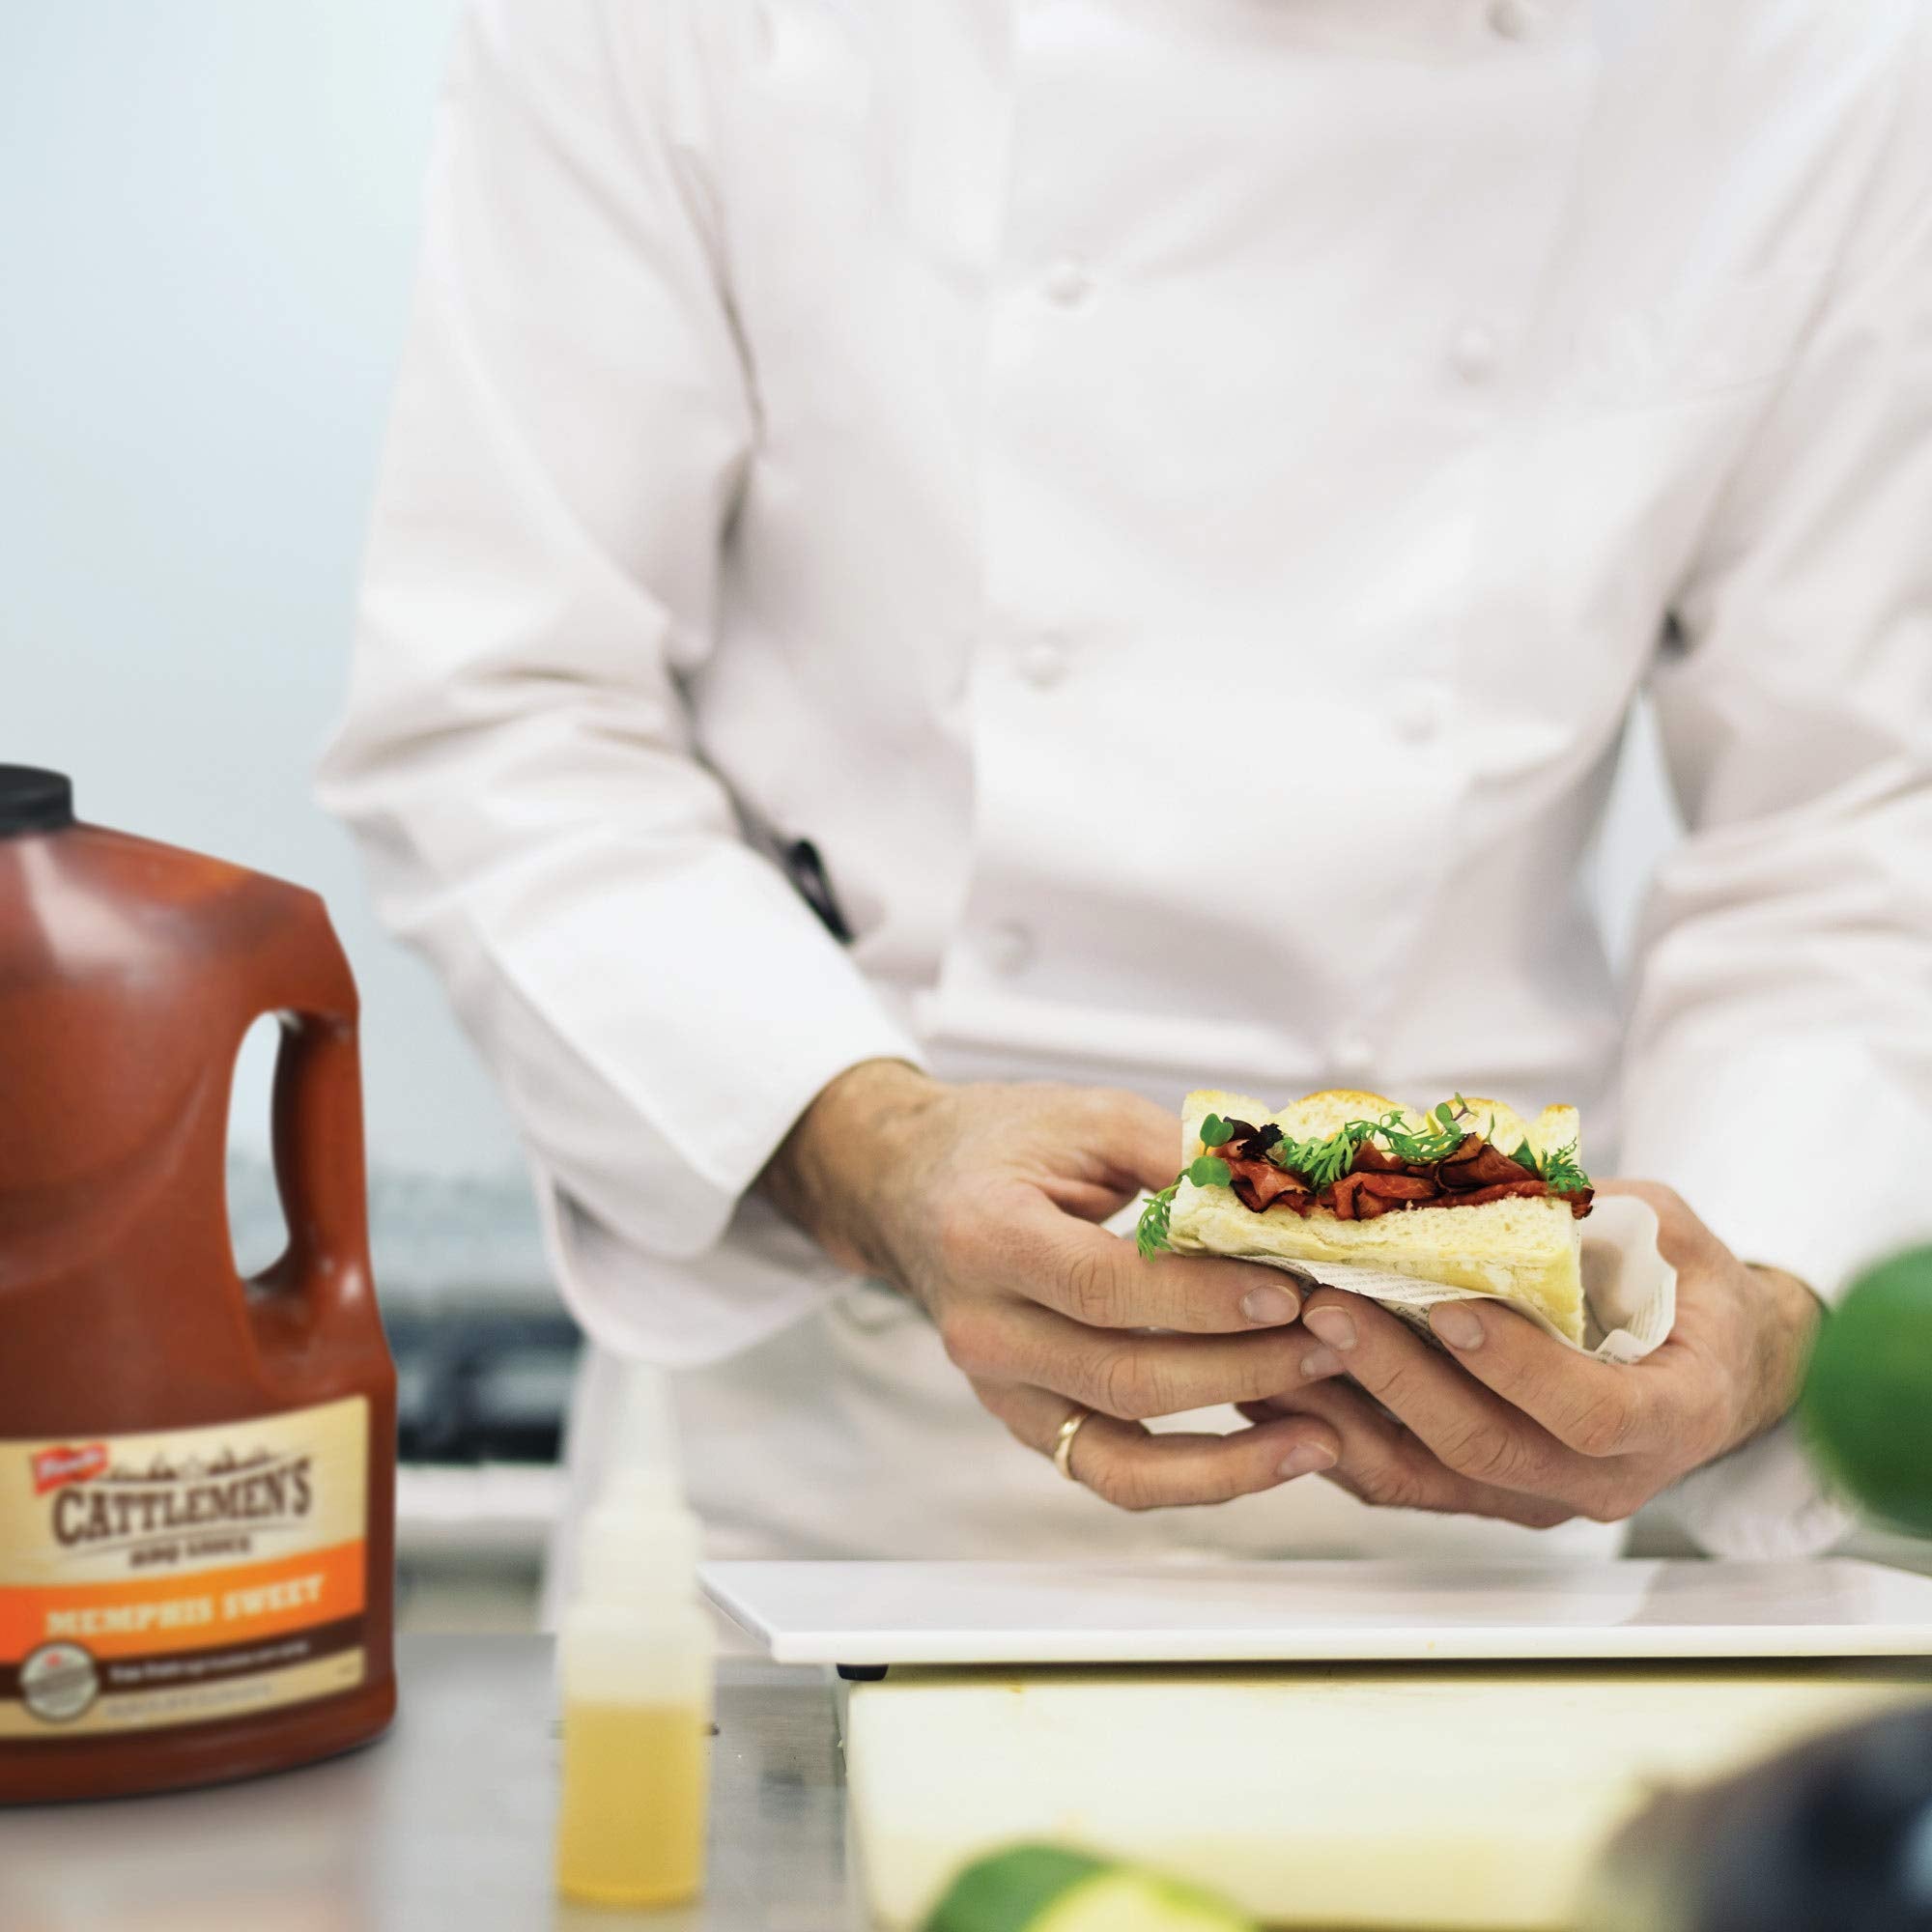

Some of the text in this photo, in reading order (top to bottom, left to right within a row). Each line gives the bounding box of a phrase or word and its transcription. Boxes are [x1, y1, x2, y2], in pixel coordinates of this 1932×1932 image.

[54, 1459, 311, 1547] CATTLEMEN'S
[46, 1575, 324, 1636] MEMPHIS SWEET
